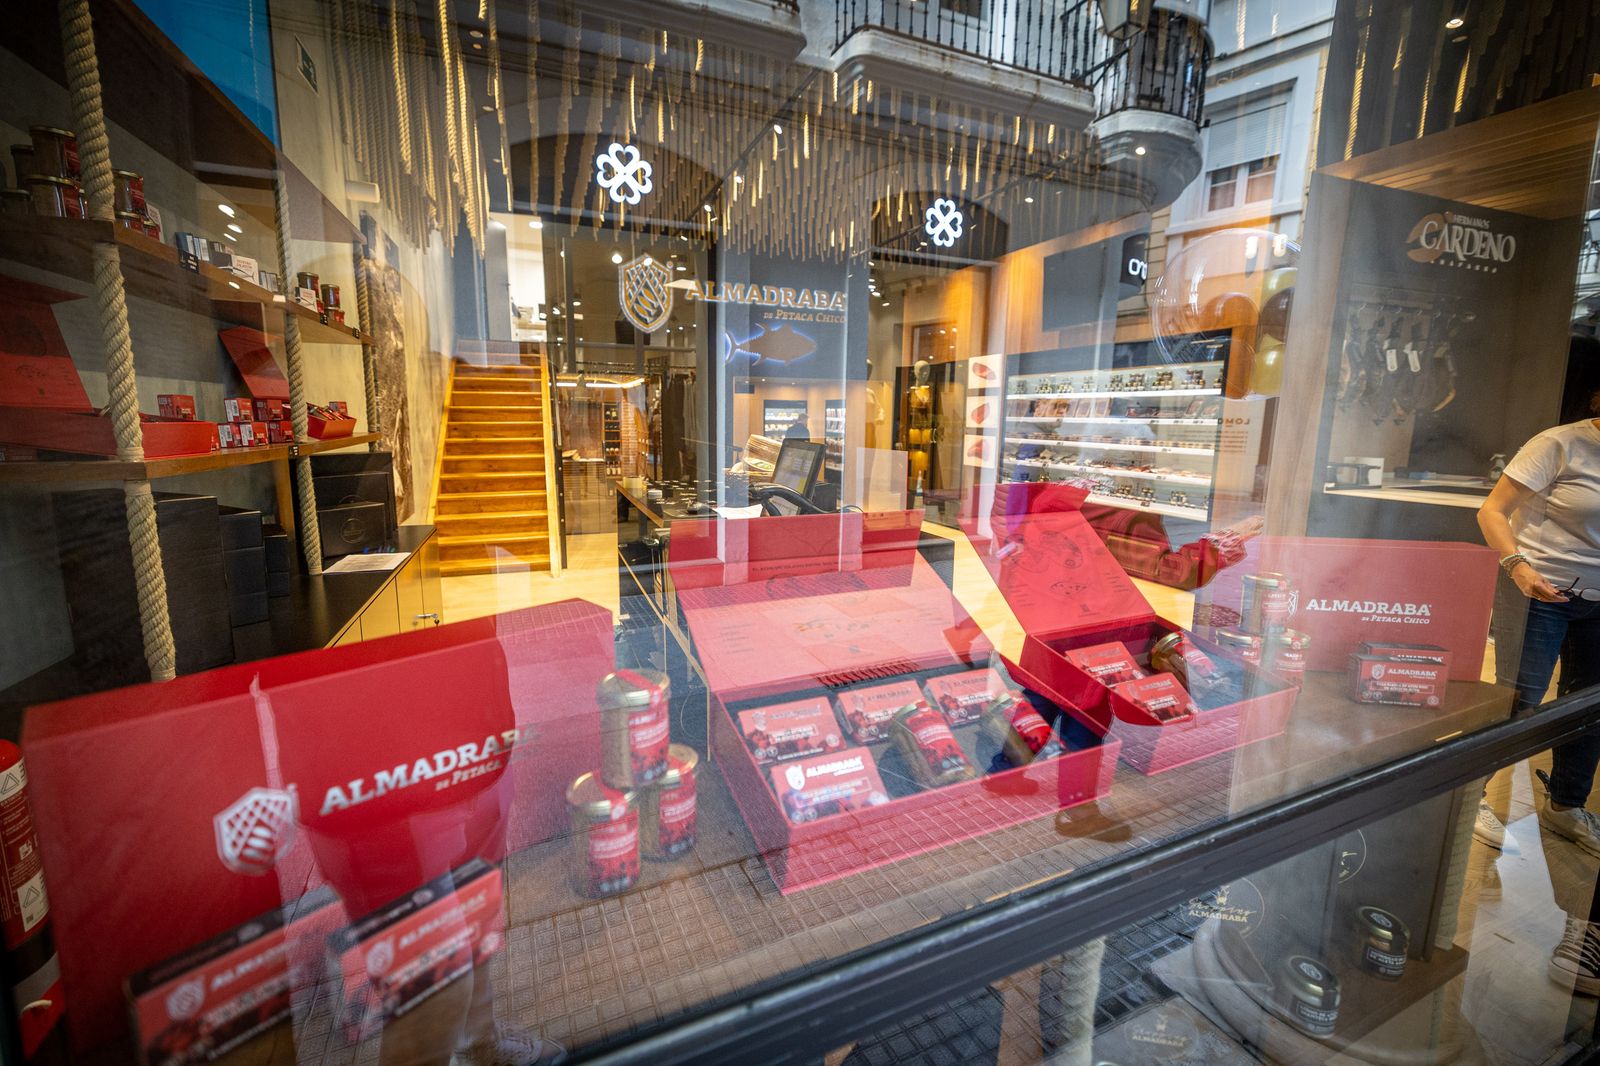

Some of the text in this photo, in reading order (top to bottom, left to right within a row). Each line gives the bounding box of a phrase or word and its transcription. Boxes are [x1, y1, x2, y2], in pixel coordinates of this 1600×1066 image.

[685, 280, 848, 312] ALMADRABA
[1306, 598, 1432, 616] ALMADRABA
[1387, 668, 1437, 677] ALMADRABA
[1188, 910, 1249, 922] ALMADRABA
